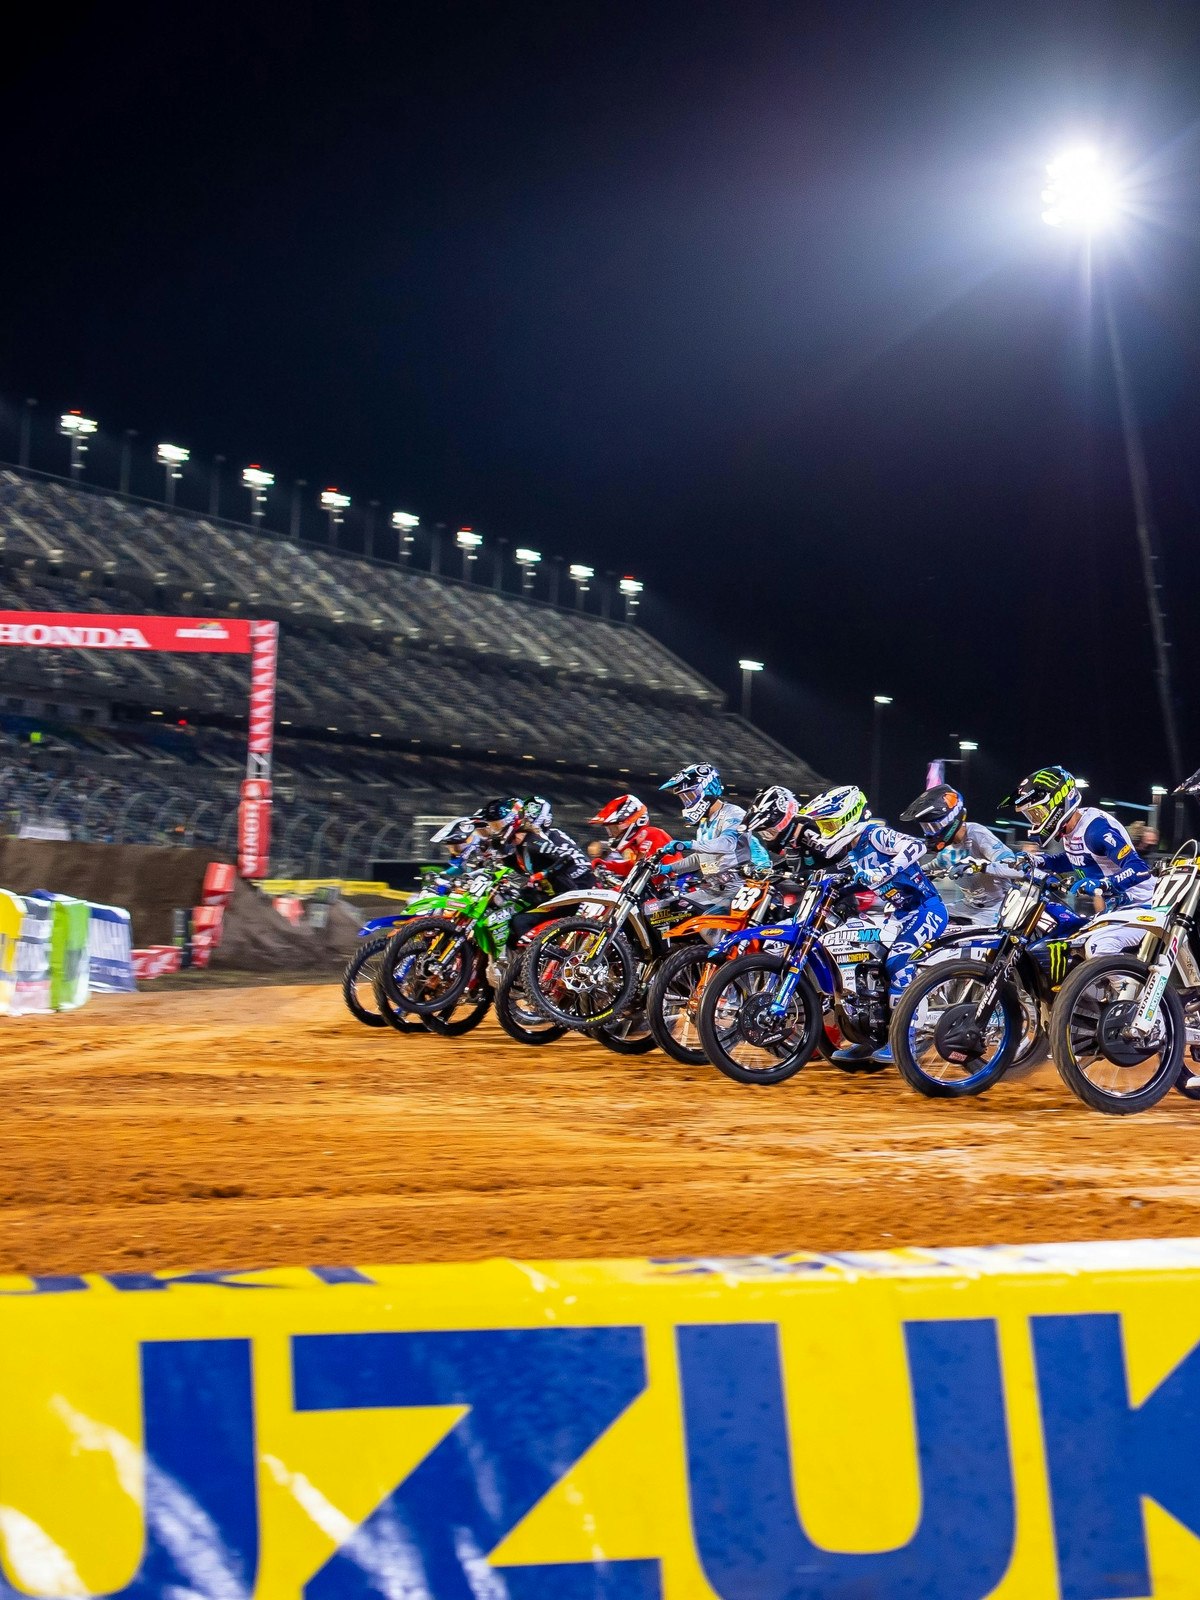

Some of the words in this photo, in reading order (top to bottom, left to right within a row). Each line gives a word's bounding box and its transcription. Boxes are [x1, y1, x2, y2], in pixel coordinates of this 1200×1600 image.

[0, 623, 152, 648] HONDA
[1047, 776, 1076, 811] 100%
[840, 800, 864, 826] 100%
[242, 804, 260, 876] HONDA
[732, 885, 761, 912] 53
[1138, 973, 1158, 1018] DUNLOP
